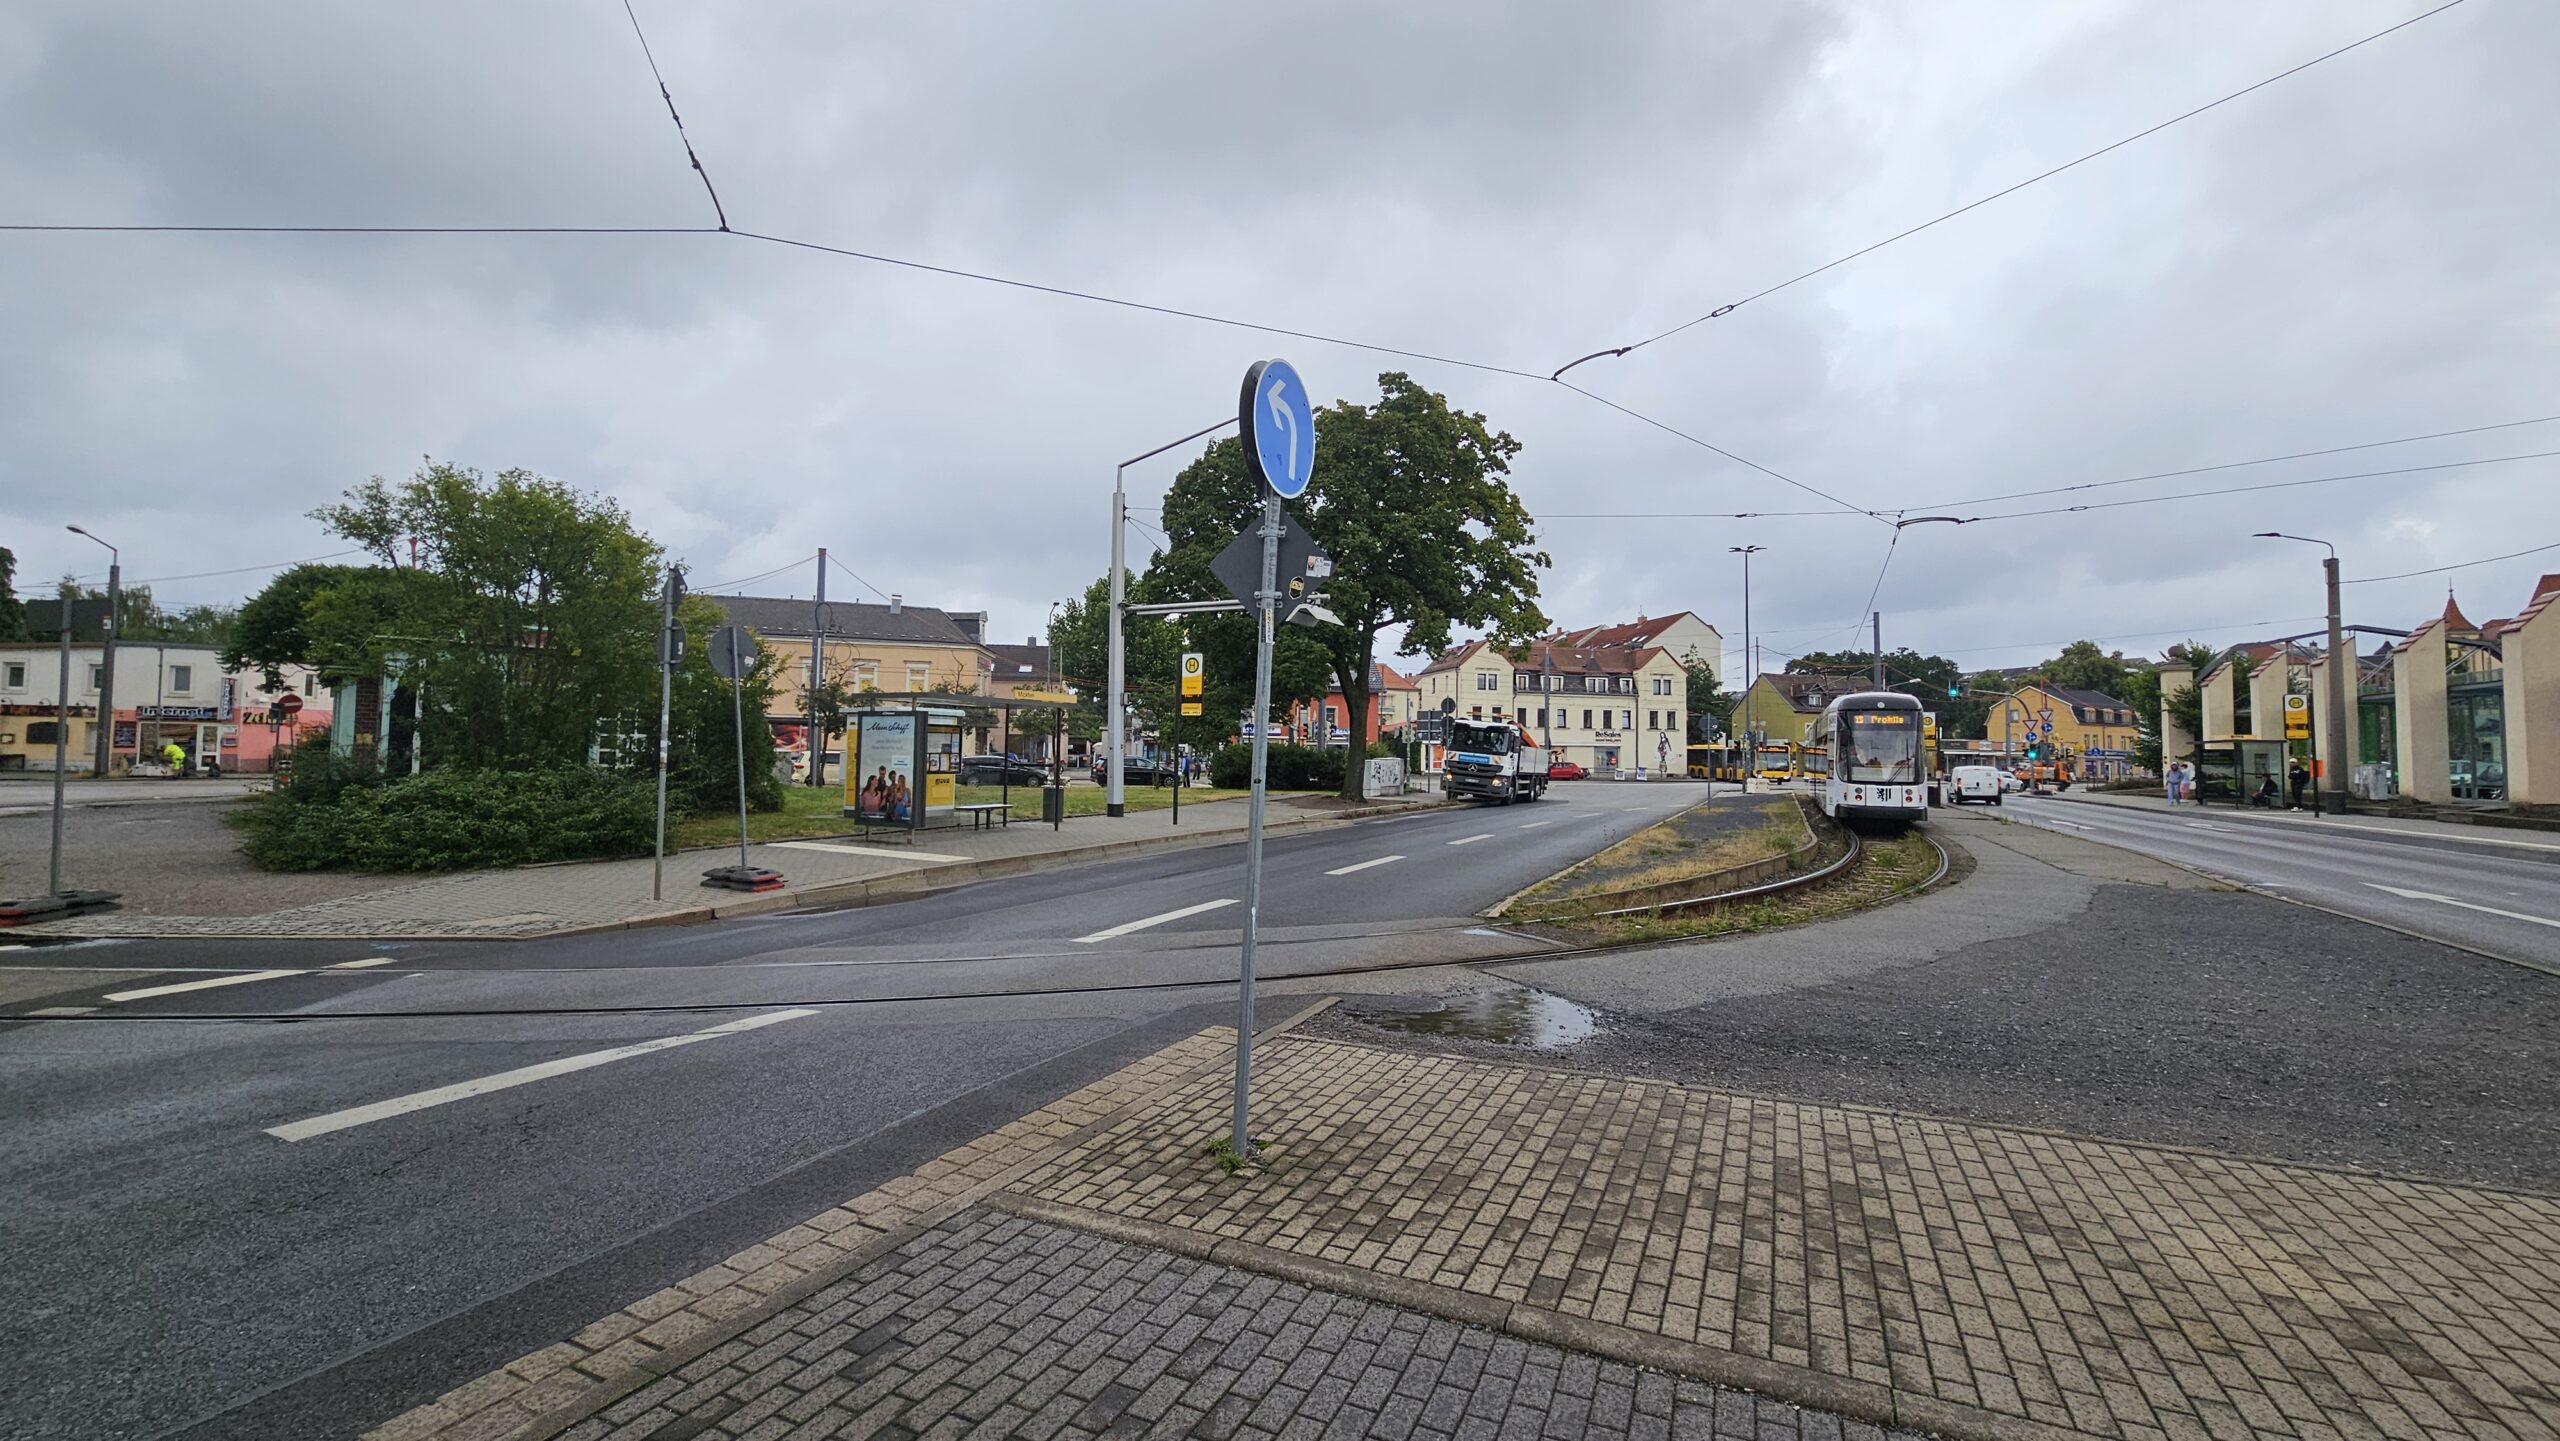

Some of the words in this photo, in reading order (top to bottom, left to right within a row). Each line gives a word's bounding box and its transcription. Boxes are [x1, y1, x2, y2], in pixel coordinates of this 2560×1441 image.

[1871, 715, 1904, 724] Prohlis
[866, 721, 888, 732] Mein
[888, 721, 910, 734] Schiff
